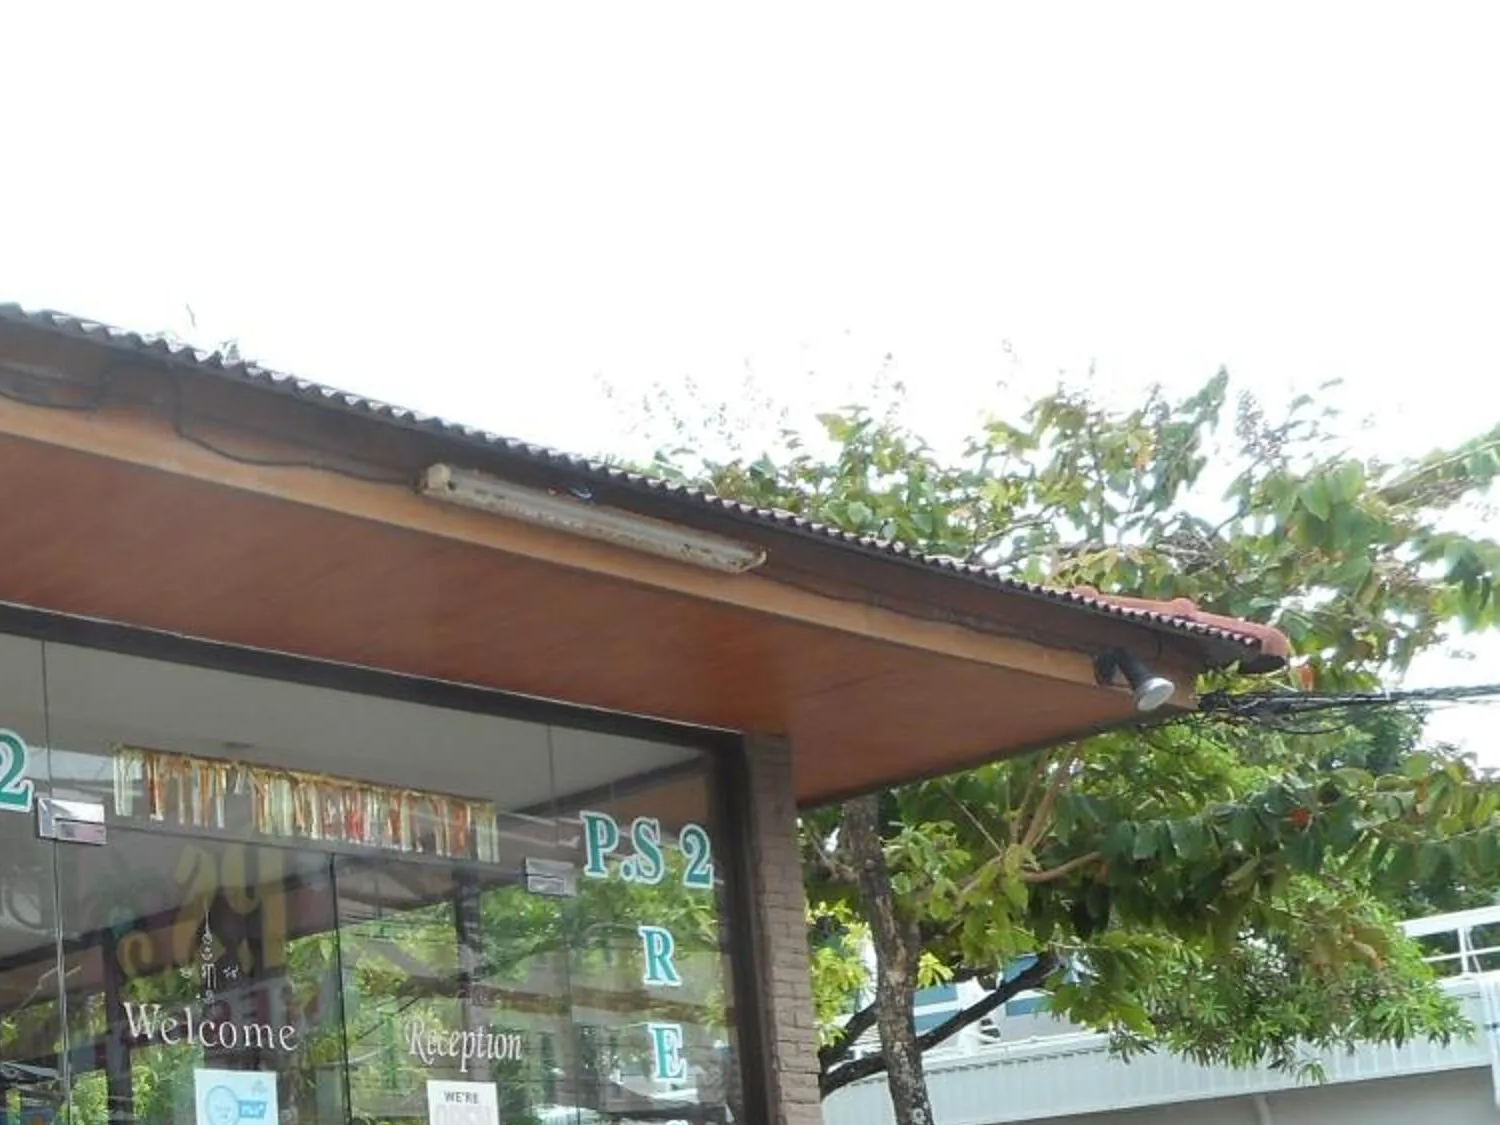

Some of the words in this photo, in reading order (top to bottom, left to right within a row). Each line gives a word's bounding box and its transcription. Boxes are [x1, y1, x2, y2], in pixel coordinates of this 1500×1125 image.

[580, 811, 665, 885] P.S
[679, 824, 714, 889] 2
[123, 1001, 298, 1051] Welcome
[404, 1013, 523, 1073] Reception
